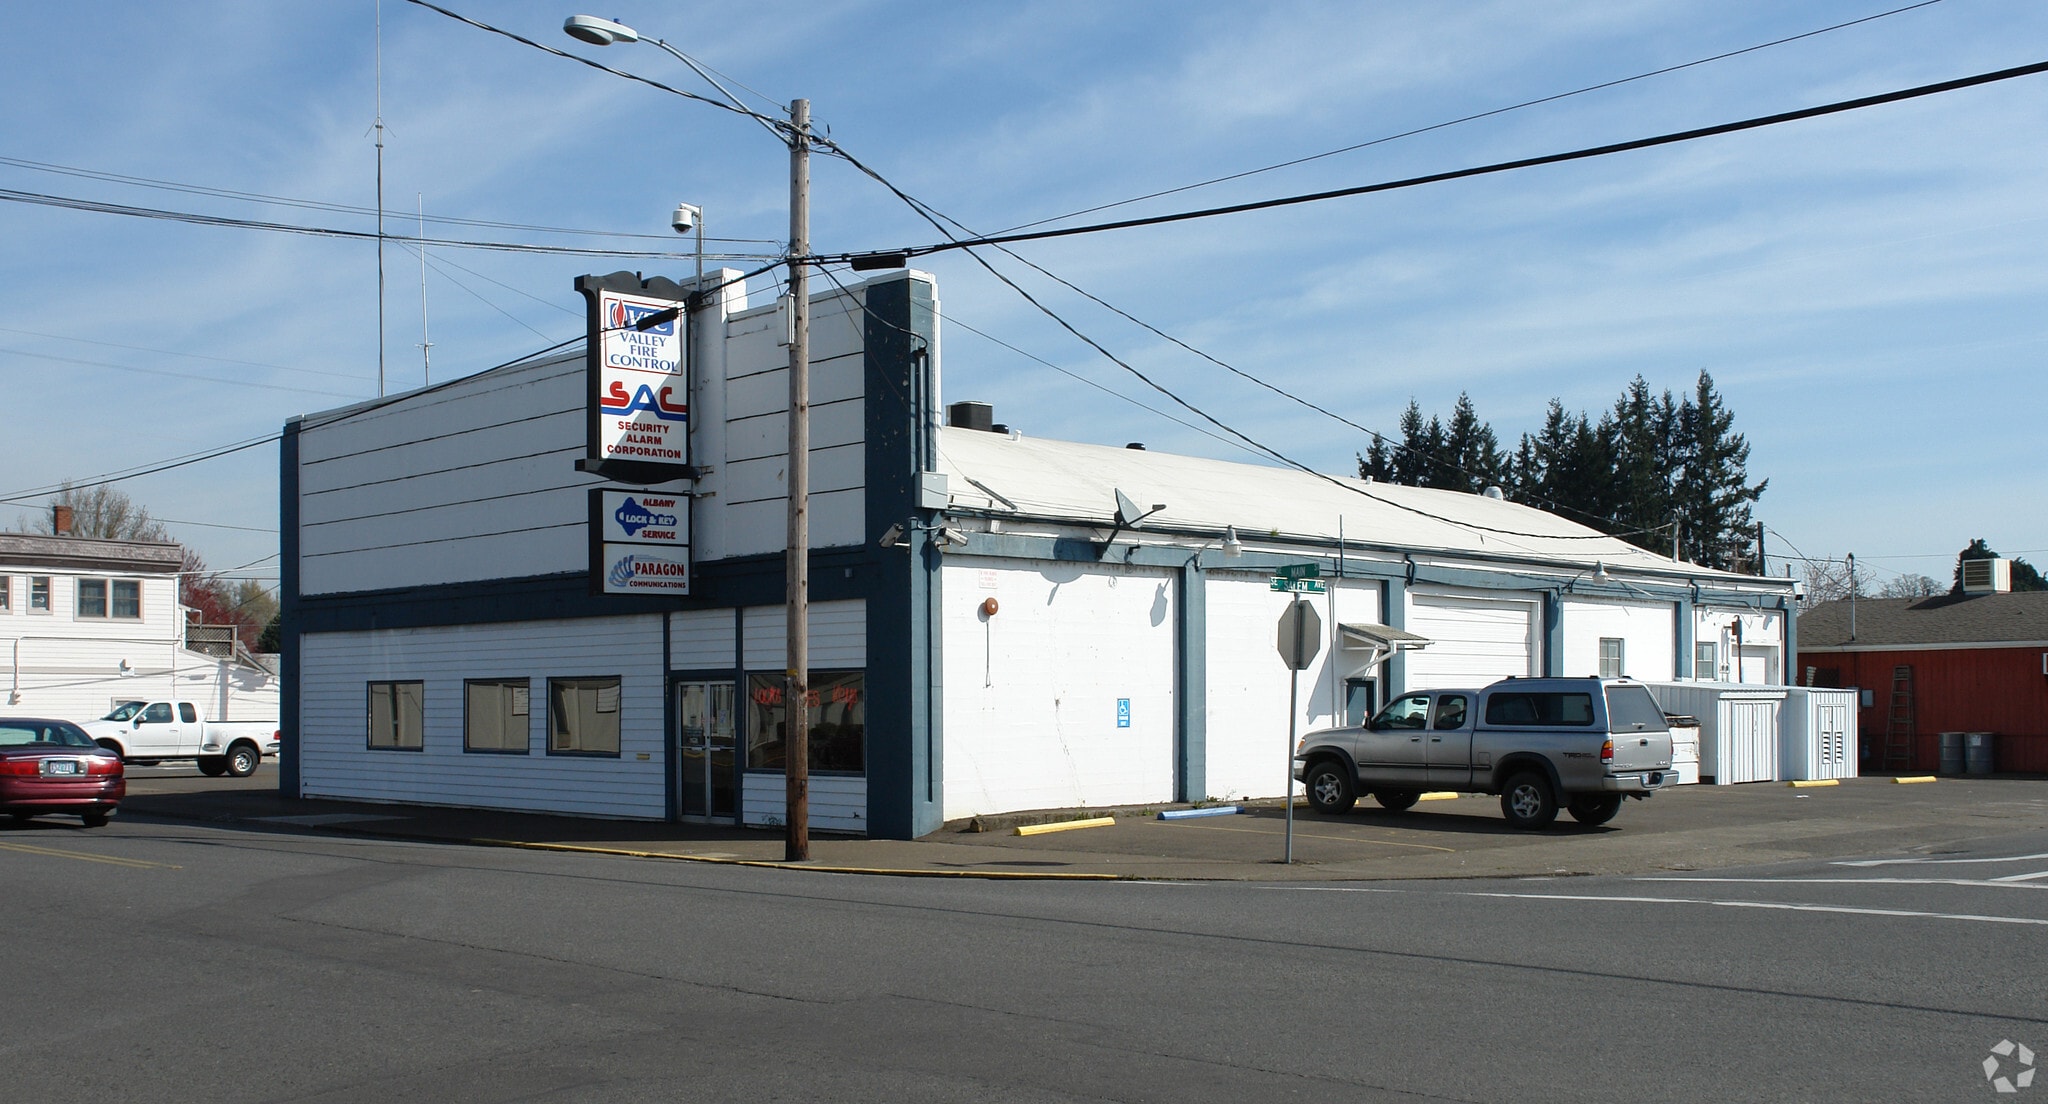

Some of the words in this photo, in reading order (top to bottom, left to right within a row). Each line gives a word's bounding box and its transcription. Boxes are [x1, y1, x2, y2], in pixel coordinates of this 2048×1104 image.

[620, 332, 667, 347] VALLEY
[630, 345, 658, 358] FIRE
[610, 353, 678, 372] CONTROL
[601, 381, 687, 417] SAC
[618, 421, 670, 434] SECURITY
[626, 434, 662, 445] ALARM
[607, 444, 681, 459] CORPORATION
[643, 498, 675, 508] ALBANY
[625, 514, 648, 524] LOCK
[649, 515, 657, 524] &
[658, 516, 674, 525] KEY
[642, 530, 676, 539] SERVICE
[635, 563, 685, 576] PARAGON
[1291, 567, 1305, 577] MAIN
[629, 580, 686, 589] COMMUNICATIONS
[1284, 581, 1308, 591] SALEM
